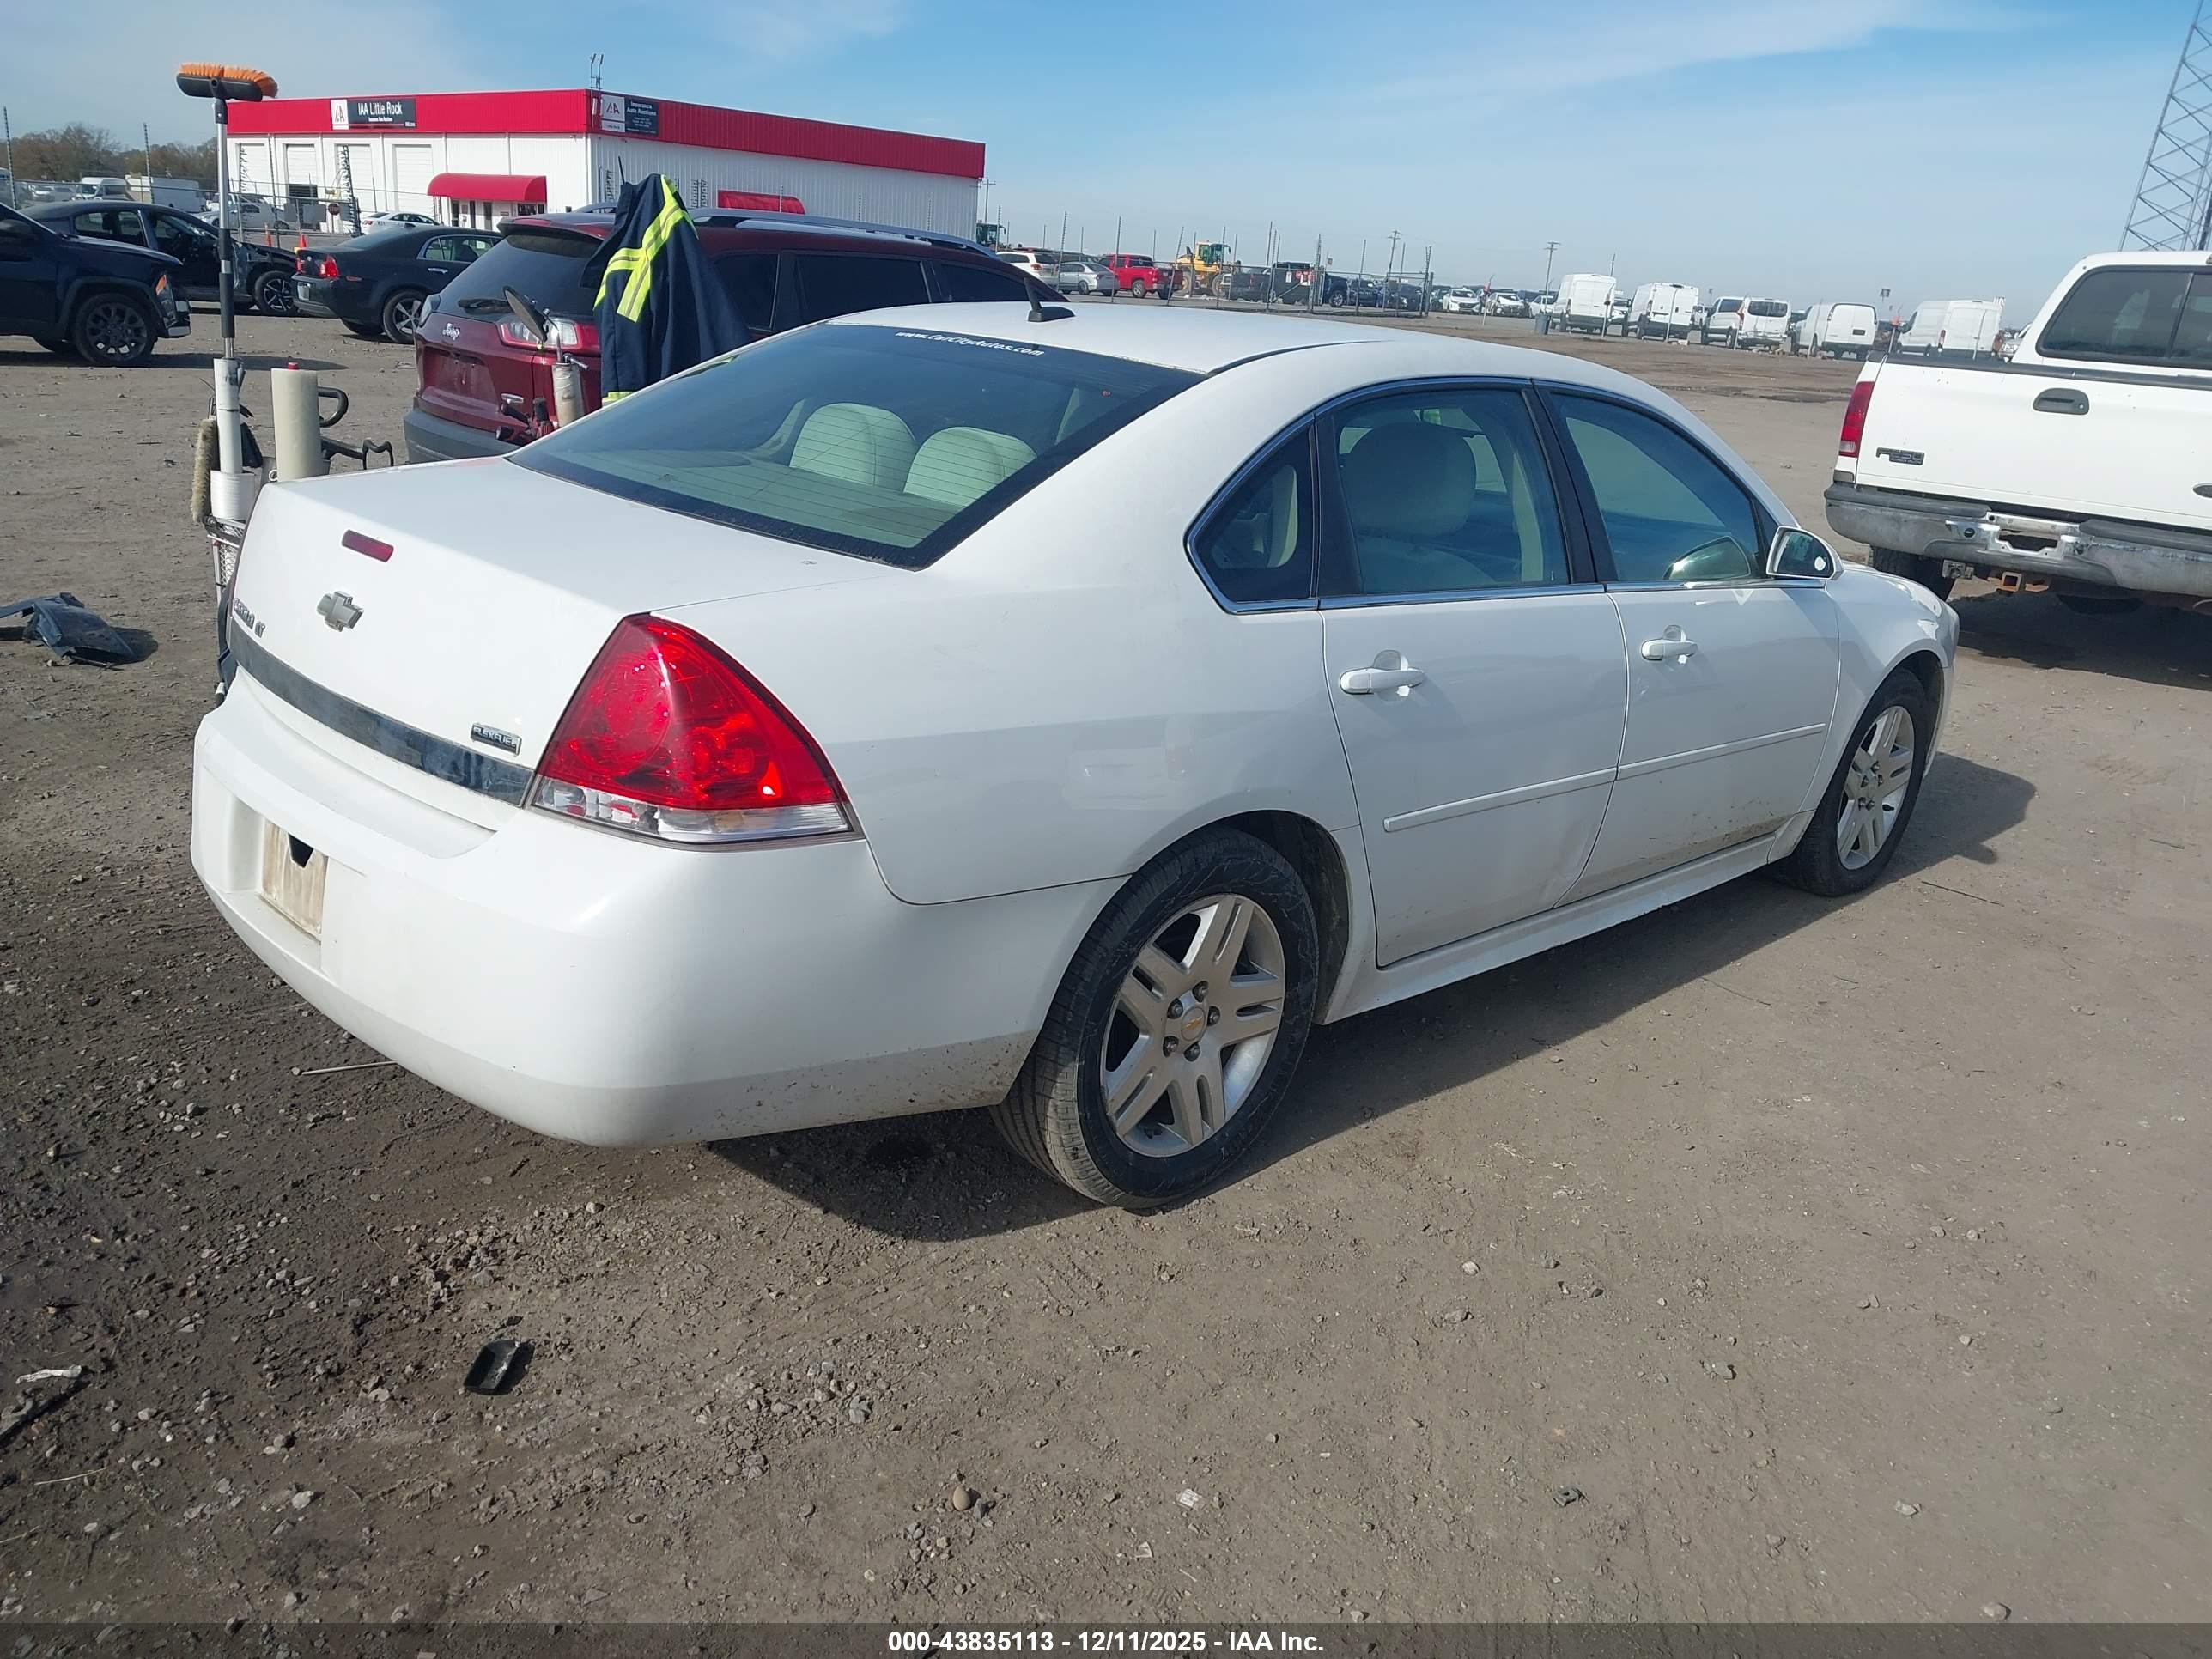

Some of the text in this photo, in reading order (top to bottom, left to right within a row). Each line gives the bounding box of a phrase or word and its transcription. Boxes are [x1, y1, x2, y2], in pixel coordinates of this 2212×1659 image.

[357, 101, 403, 116] IAA Little Rock
